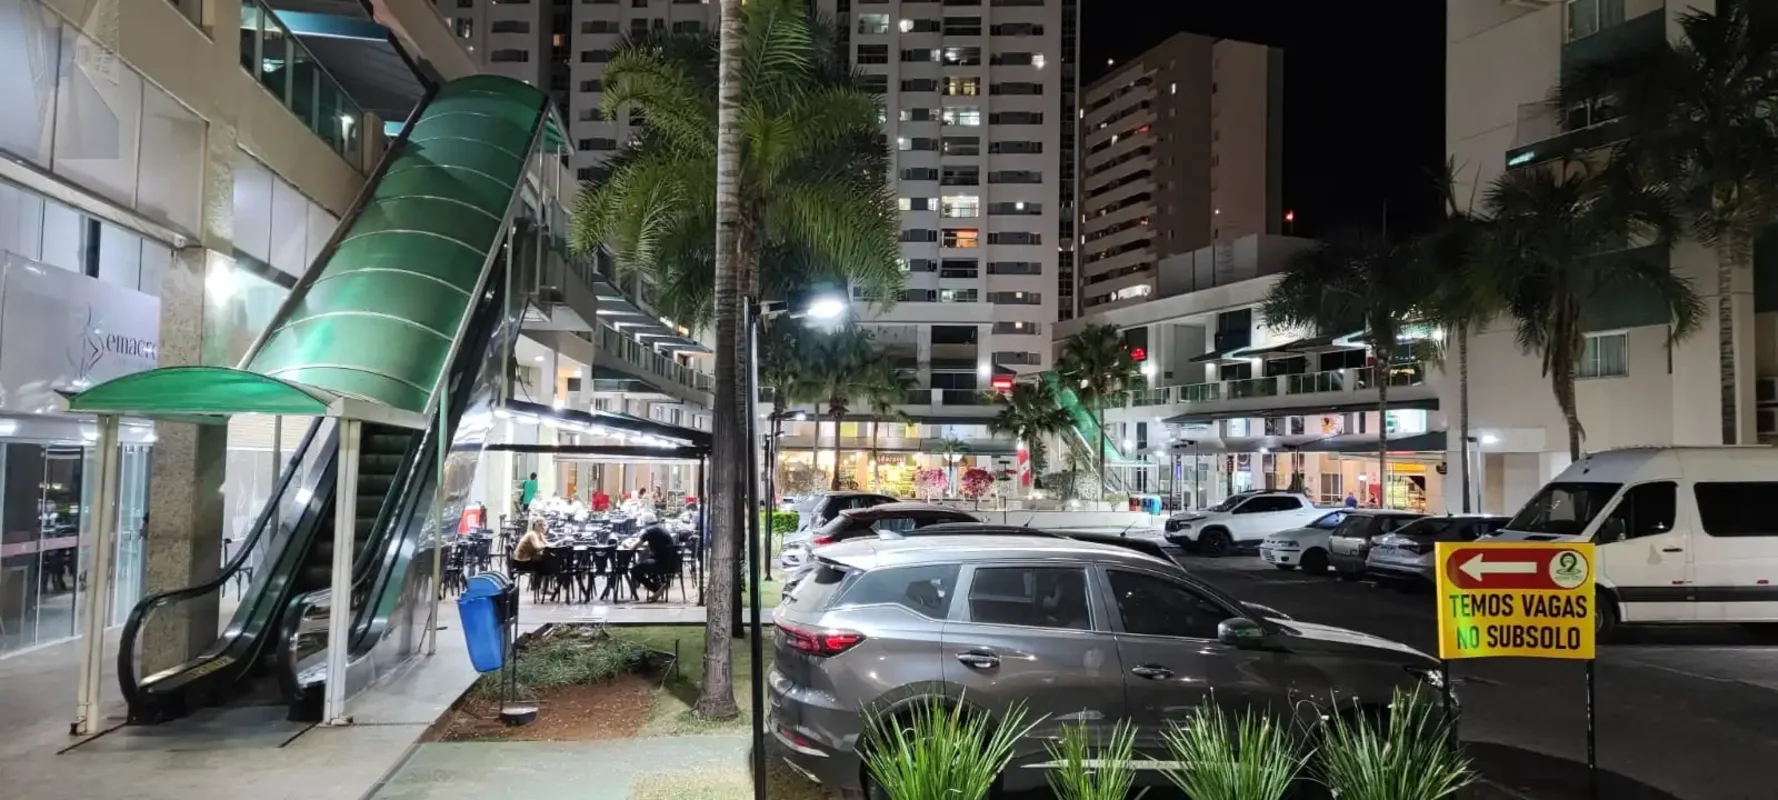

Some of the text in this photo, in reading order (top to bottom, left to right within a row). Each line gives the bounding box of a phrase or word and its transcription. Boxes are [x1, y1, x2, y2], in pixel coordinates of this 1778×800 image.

[1449, 594, 1587, 618] TEMOS VAGAS
[1457, 625, 1580, 650] NO SUBSOLO
